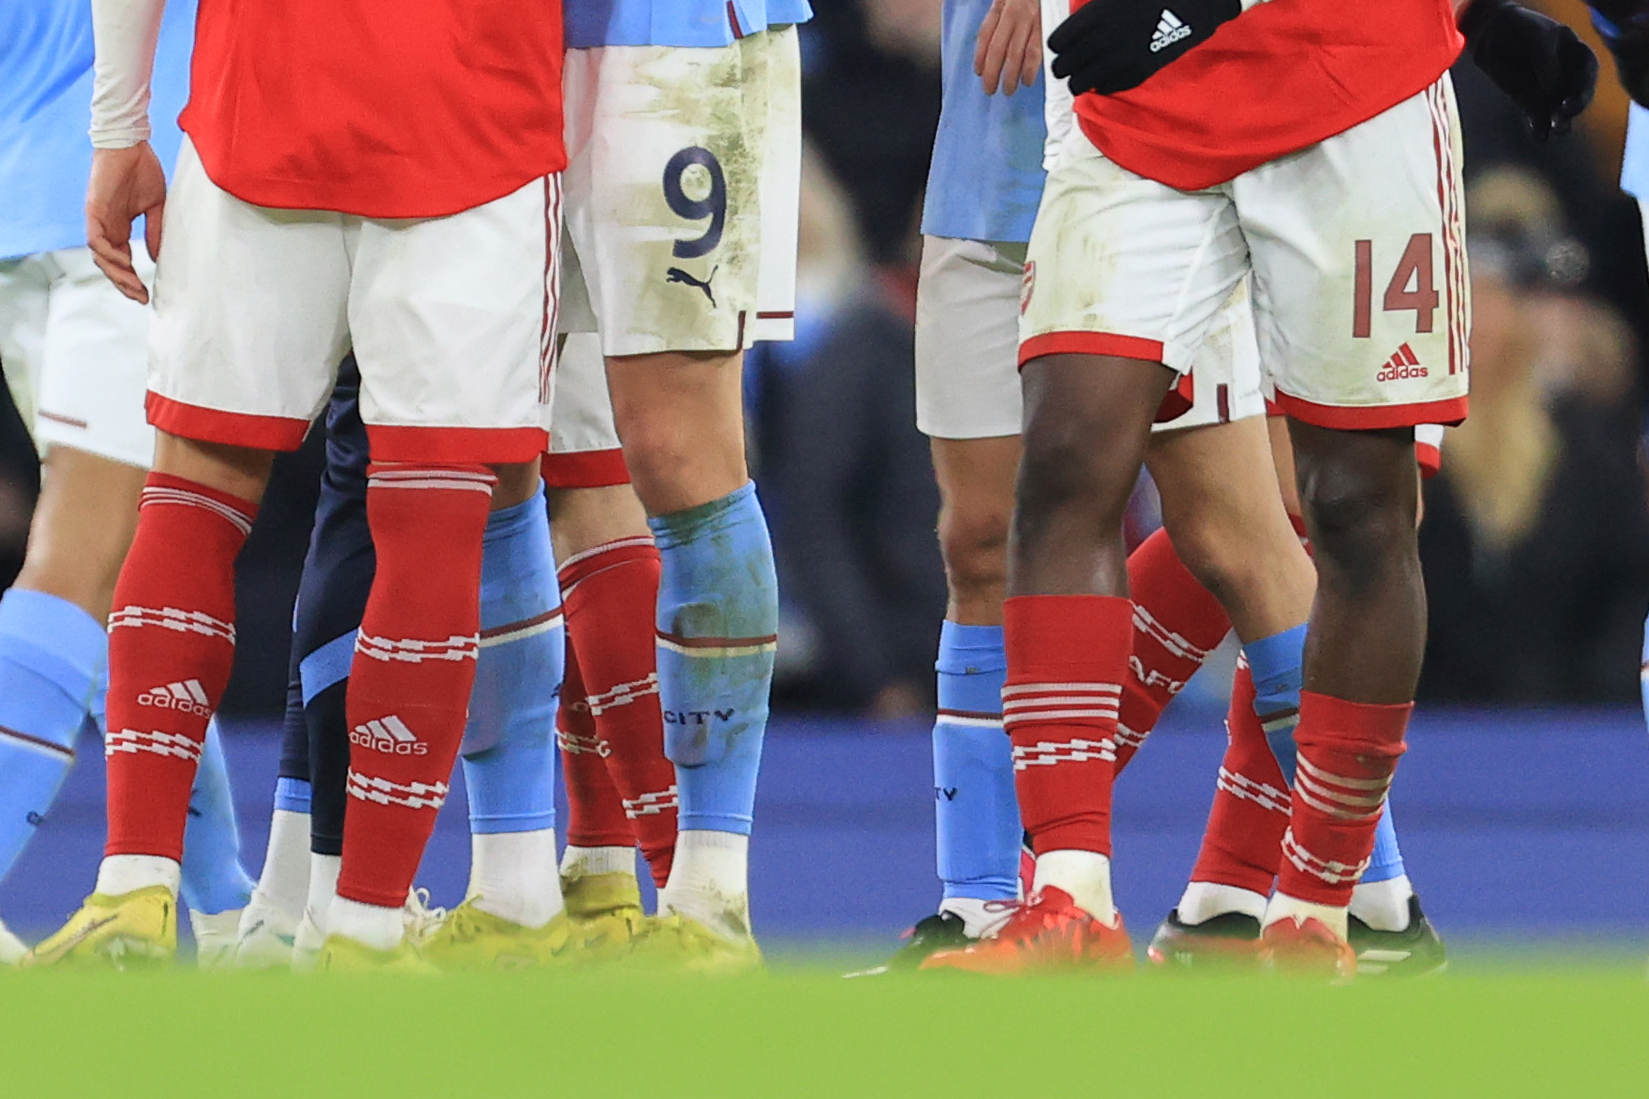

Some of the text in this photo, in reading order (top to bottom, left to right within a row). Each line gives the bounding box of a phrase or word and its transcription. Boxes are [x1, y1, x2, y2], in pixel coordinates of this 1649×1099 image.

[1149, 24, 1193, 53] adidas
[662, 146, 728, 259] 9
[1352, 232, 1440, 339] 14
[1376, 366, 1429, 383] adidas
[137, 692, 212, 720] adidas
[663, 707, 736, 726] CITY
[348, 731, 429, 756] adidas
